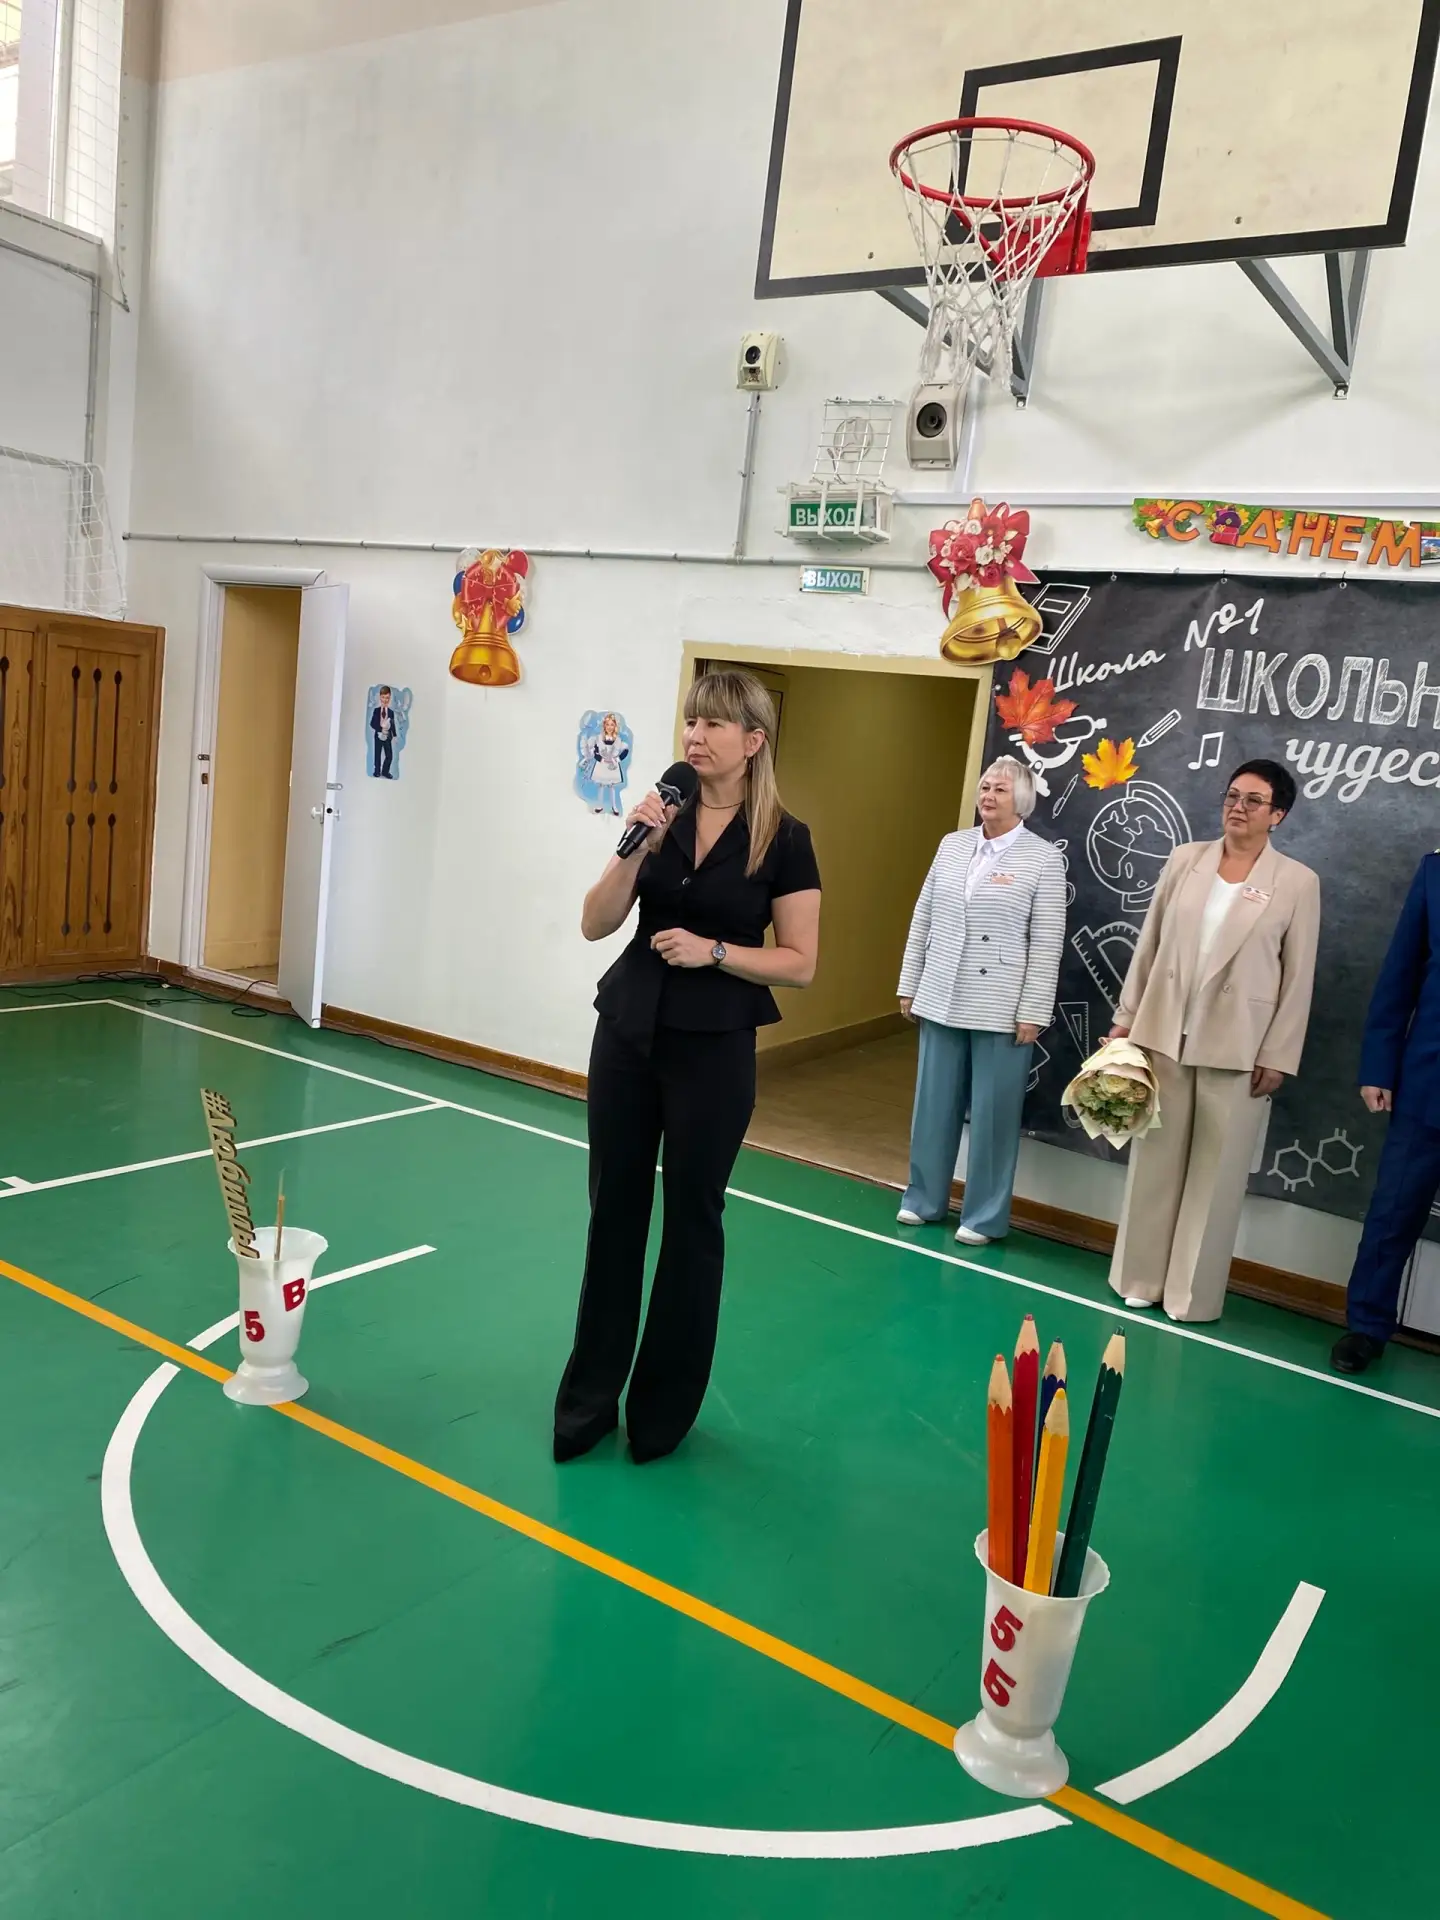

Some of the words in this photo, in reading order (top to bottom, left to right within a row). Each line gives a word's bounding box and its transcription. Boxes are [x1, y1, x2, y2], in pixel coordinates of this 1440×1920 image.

[795, 507, 858, 526] ВЫХОД
[1164, 501, 1204, 542] С
[1236, 508, 1421, 568] ДНЕМ
[806, 569, 862, 588] ВЫХОД
[1047, 650, 1166, 693] Школа
[1184, 598, 1265, 651] №1
[1196, 647, 1440, 730] ШКОЛЬН
[1286, 738, 1440, 804] чудес
[244, 1310, 266, 1343] 5
[282, 1277, 306, 1312] В
[990, 1604, 1024, 1652] 5
